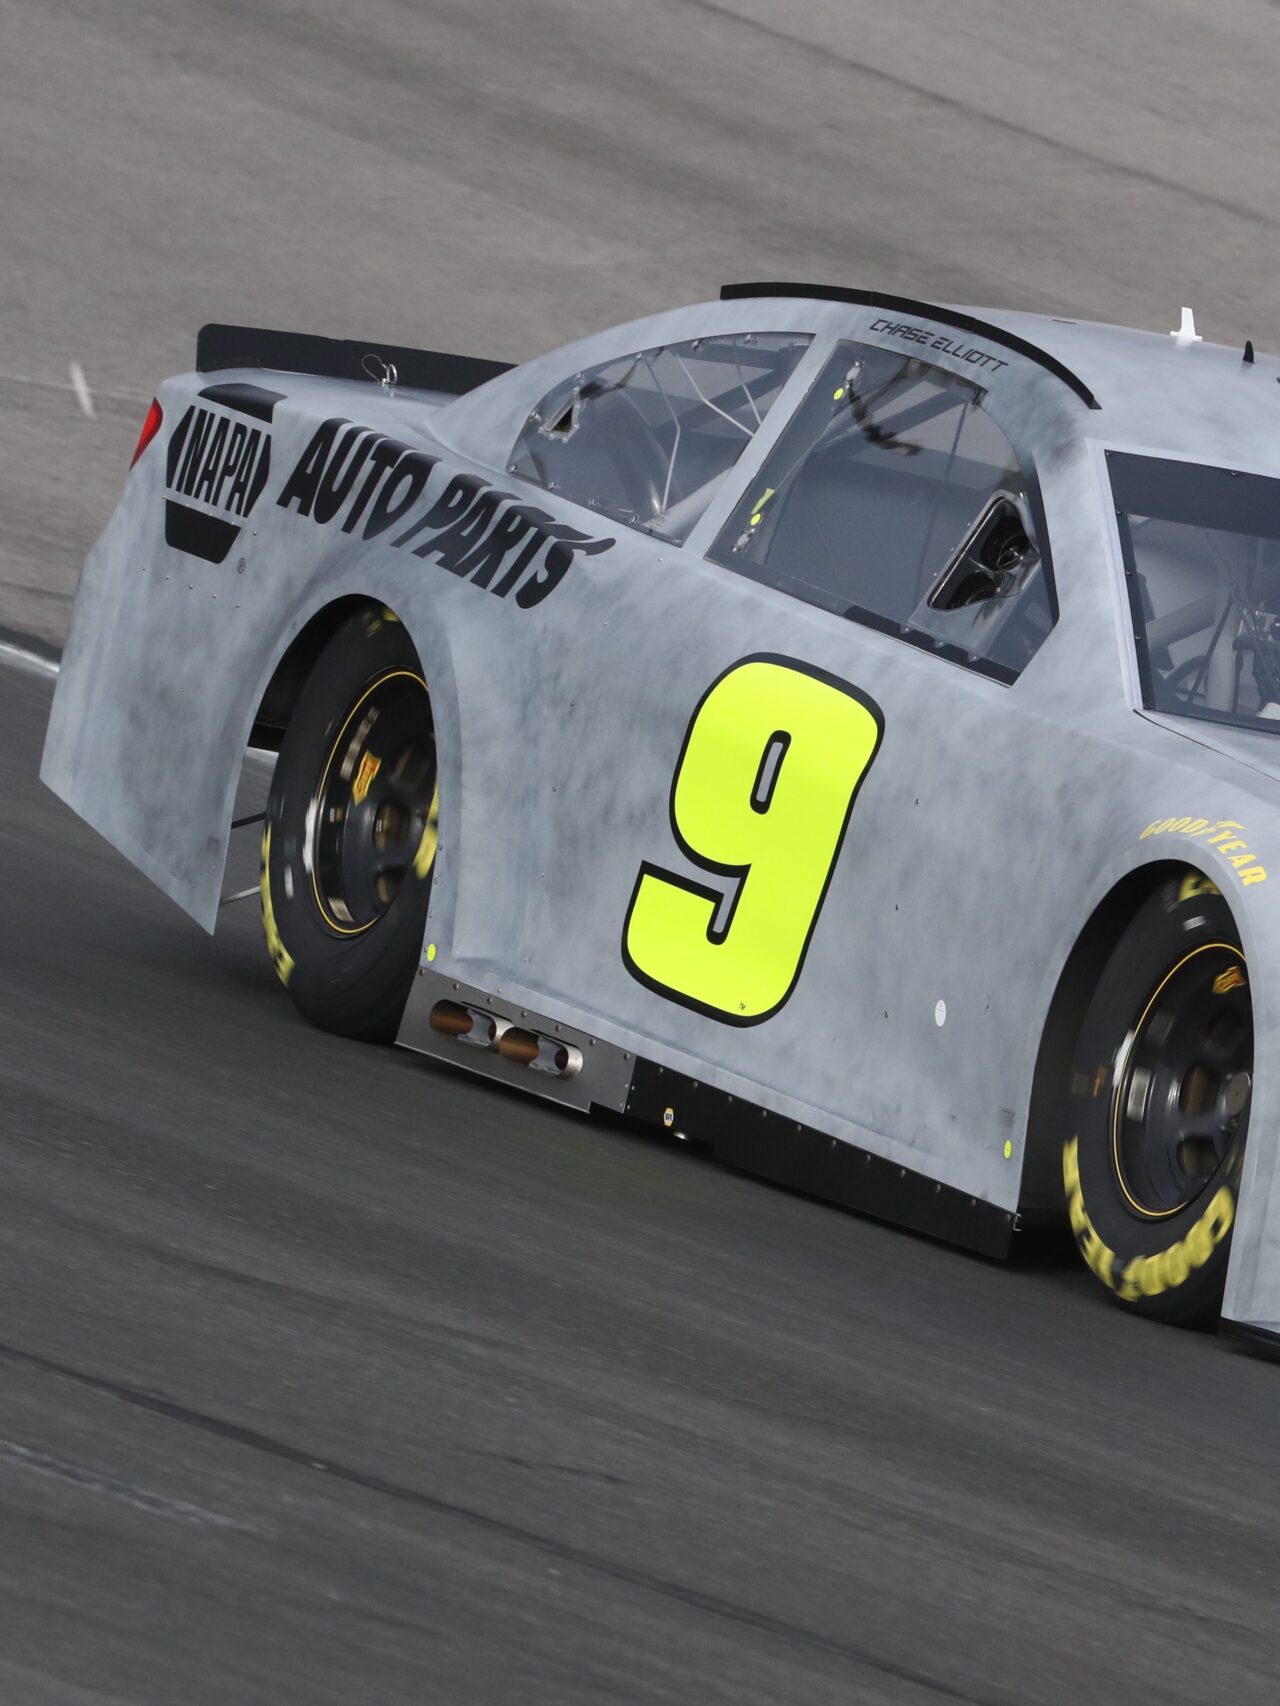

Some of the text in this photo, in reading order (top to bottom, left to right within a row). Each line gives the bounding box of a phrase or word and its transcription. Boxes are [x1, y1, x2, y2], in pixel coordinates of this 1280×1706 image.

[869, 318, 1009, 372] CHASE ELLIOTT
[176, 408, 262, 516] NAPA
[276, 417, 616, 609] AUTO PARTS
[621, 652, 886, 1028] 9
